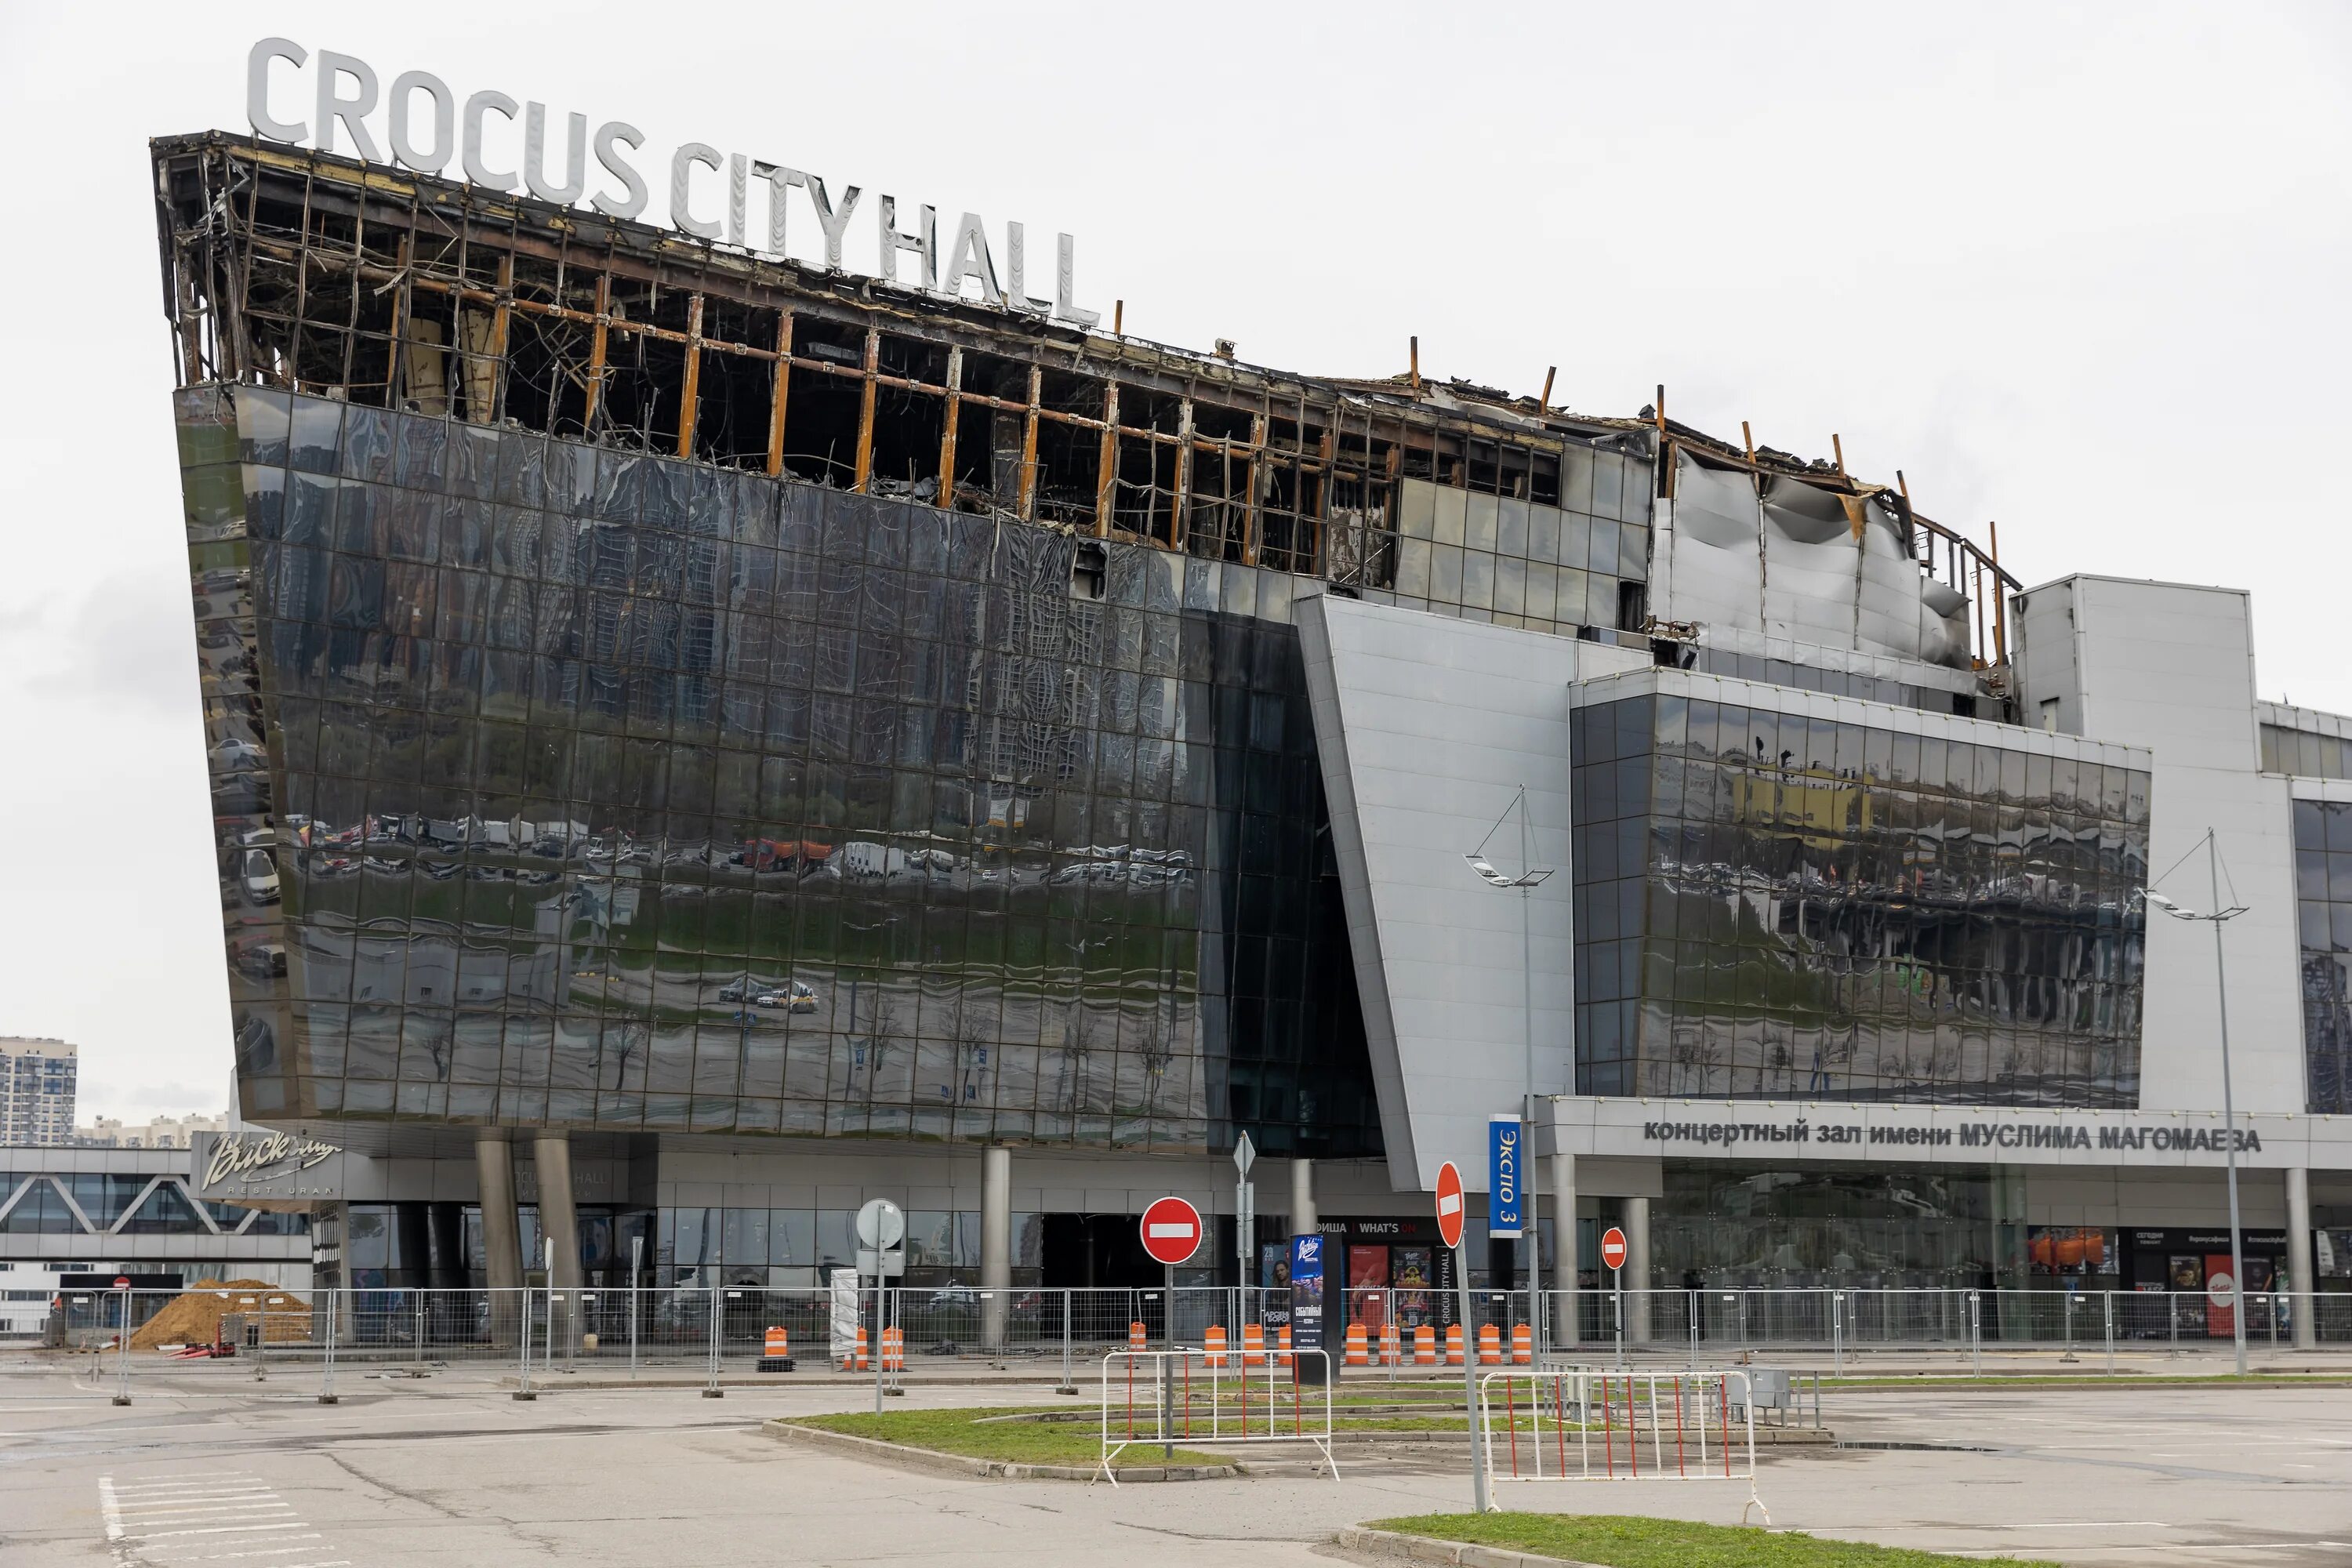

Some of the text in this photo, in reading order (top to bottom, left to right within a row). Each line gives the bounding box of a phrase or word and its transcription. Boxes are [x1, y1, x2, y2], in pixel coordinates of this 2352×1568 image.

[246, 37, 1102, 327] CROCUS CITY HALL
[1644, 1118, 2263, 1152] концертный зал имени МУСЛИМА МАГОМАЕВА
[1500, 1128, 1518, 1223] ЭКСПО 3
[1359, 1223, 1417, 1234] WHAT'S ON
[1441, 1251, 1450, 1274] HALL
[1442, 1293, 1450, 1324] CROCUS
